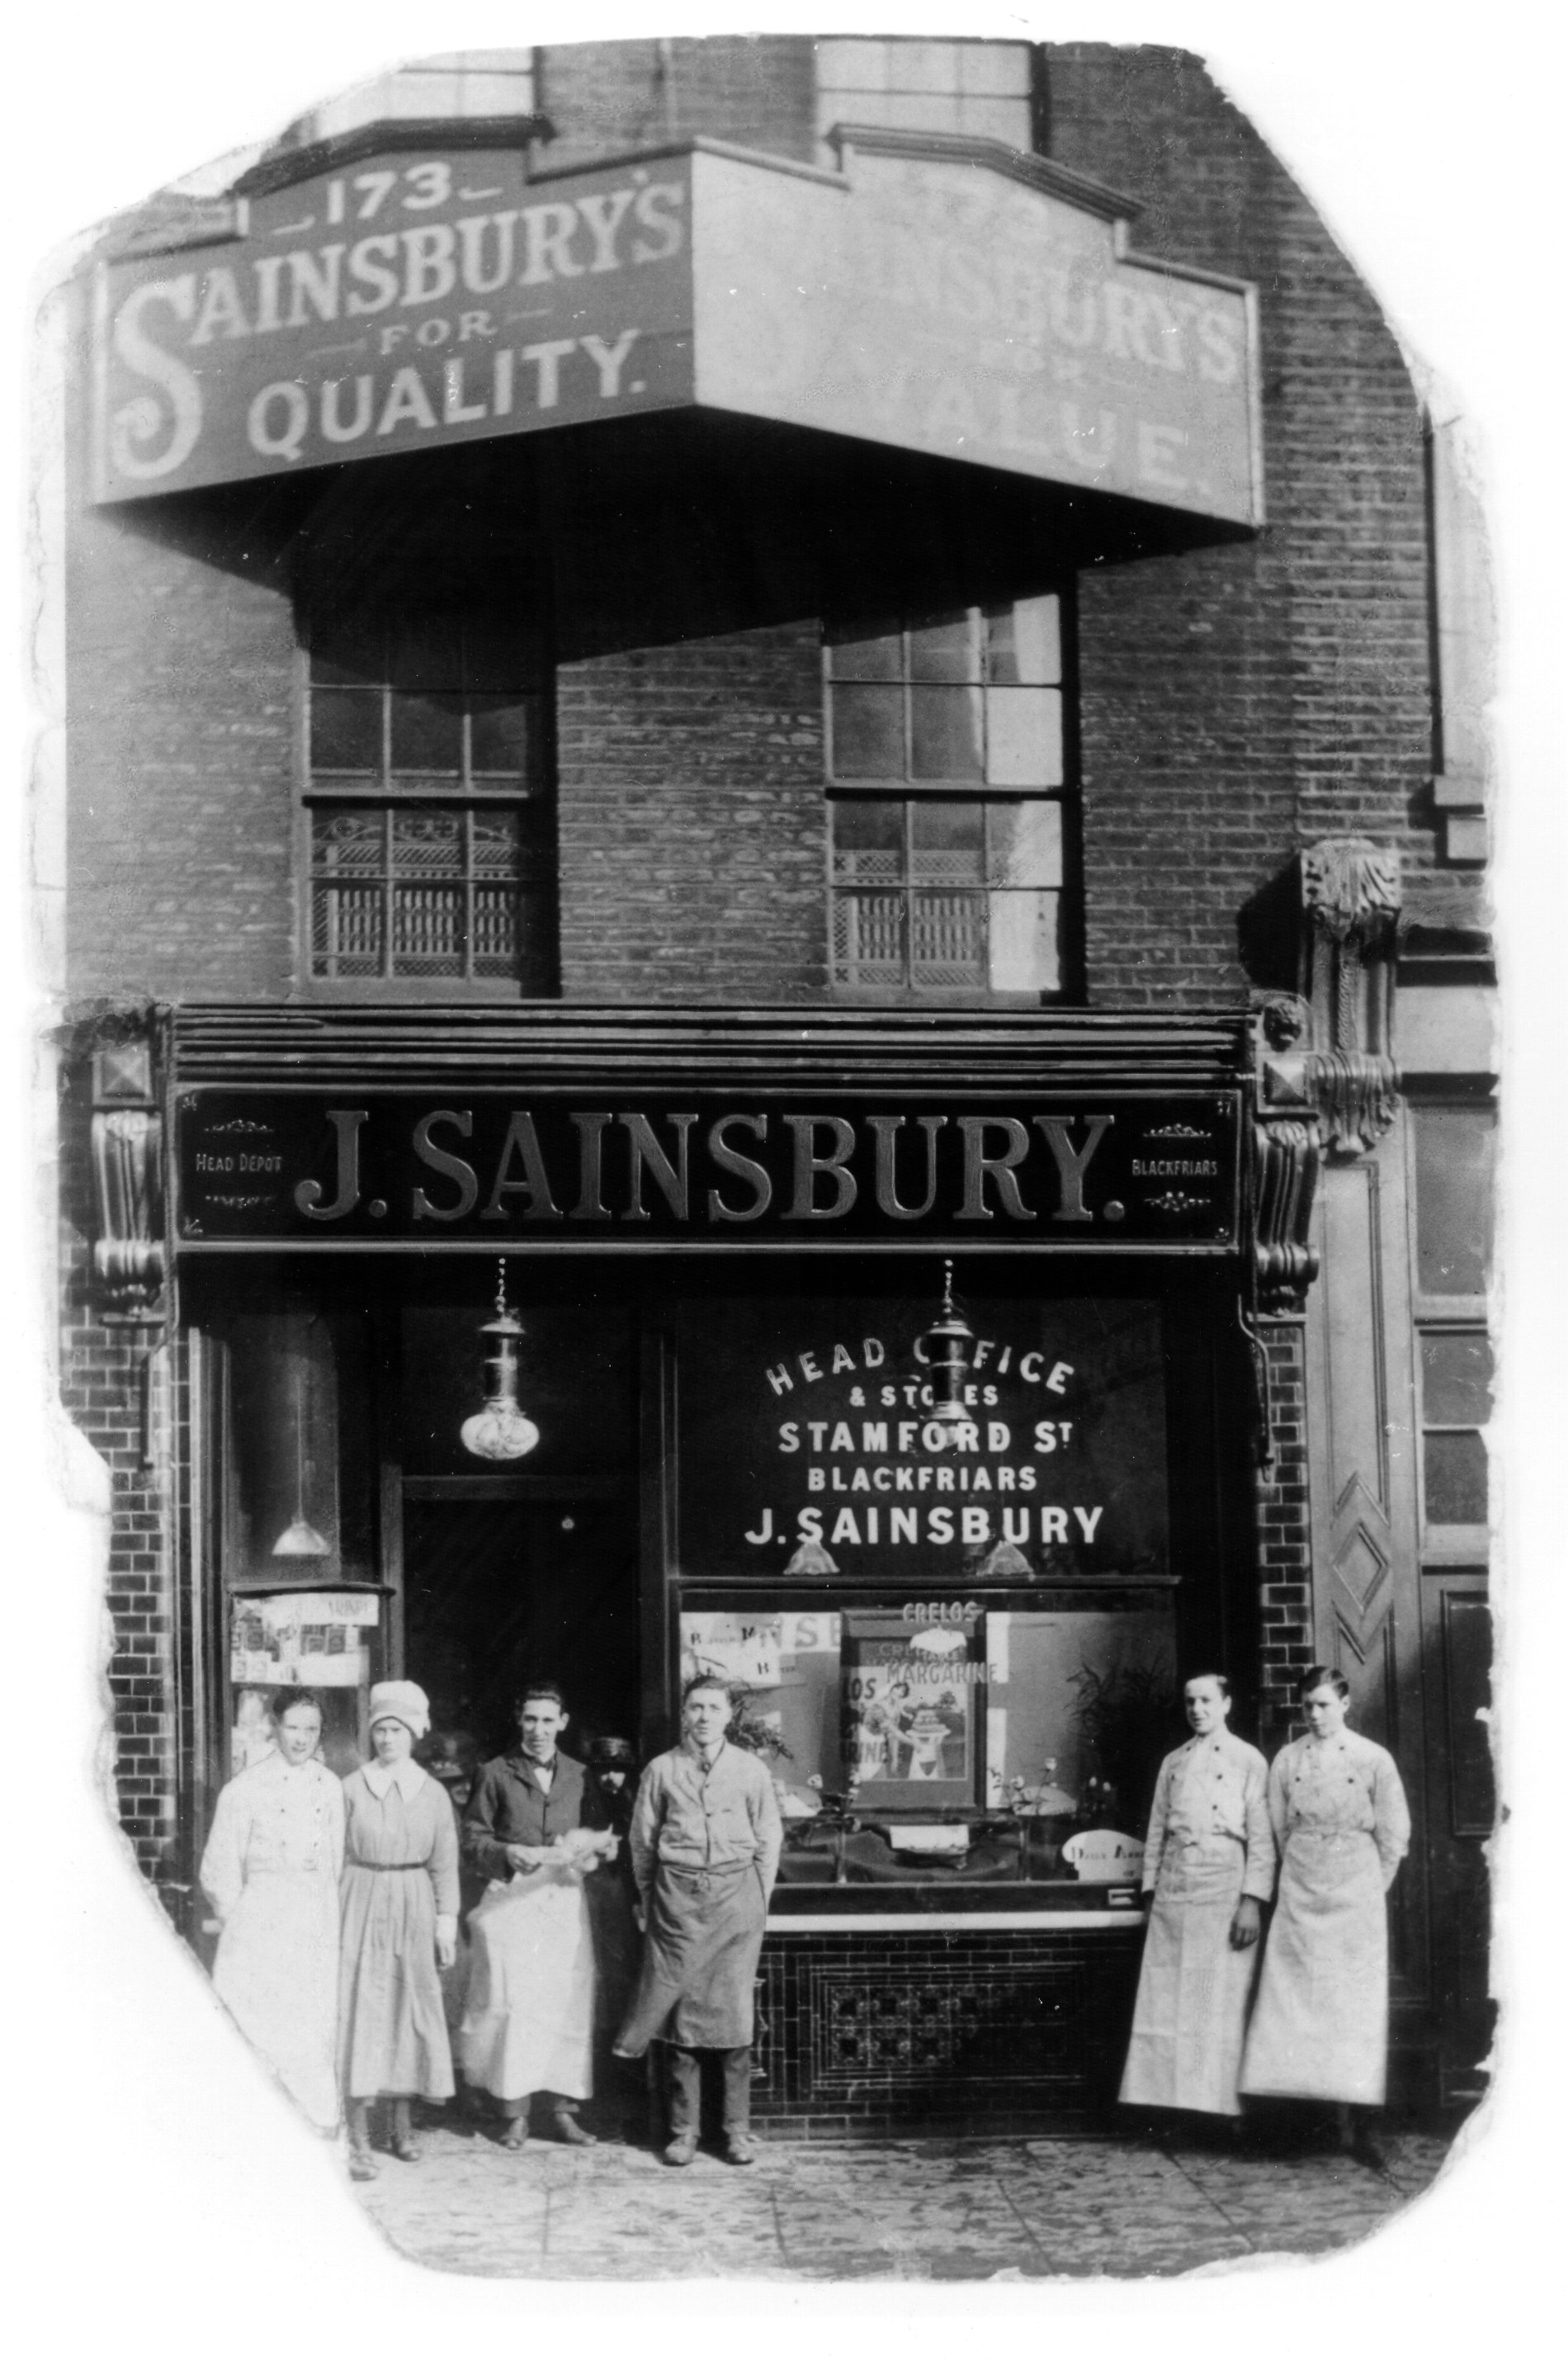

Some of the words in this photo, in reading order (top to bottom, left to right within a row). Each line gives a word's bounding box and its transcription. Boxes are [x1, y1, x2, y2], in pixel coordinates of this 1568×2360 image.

[328, 162, 452, 225] 173
[109, 170, 687, 480] SAINSBURY'S
[380, 310, 499, 355] FOR
[248, 329, 646, 462] QUALITY.
[196, 1153, 234, 1172] HEAD
[239, 1153, 282, 1172] DEPOT
[412, 1110, 1126, 1222] SAINSBURY.
[1131, 1158, 1218, 1176] BLACKFRIARS
[766, 1337, 886, 1396] HEAD
[849, 1386, 866, 1407] &
[880, 1384, 999, 1407] STOES
[778, 1421, 1012, 1453] STAMFORD
[807, 1466, 1037, 1491] BLACKFRIARS
[885, 1661, 998, 1685] MARGARINE
